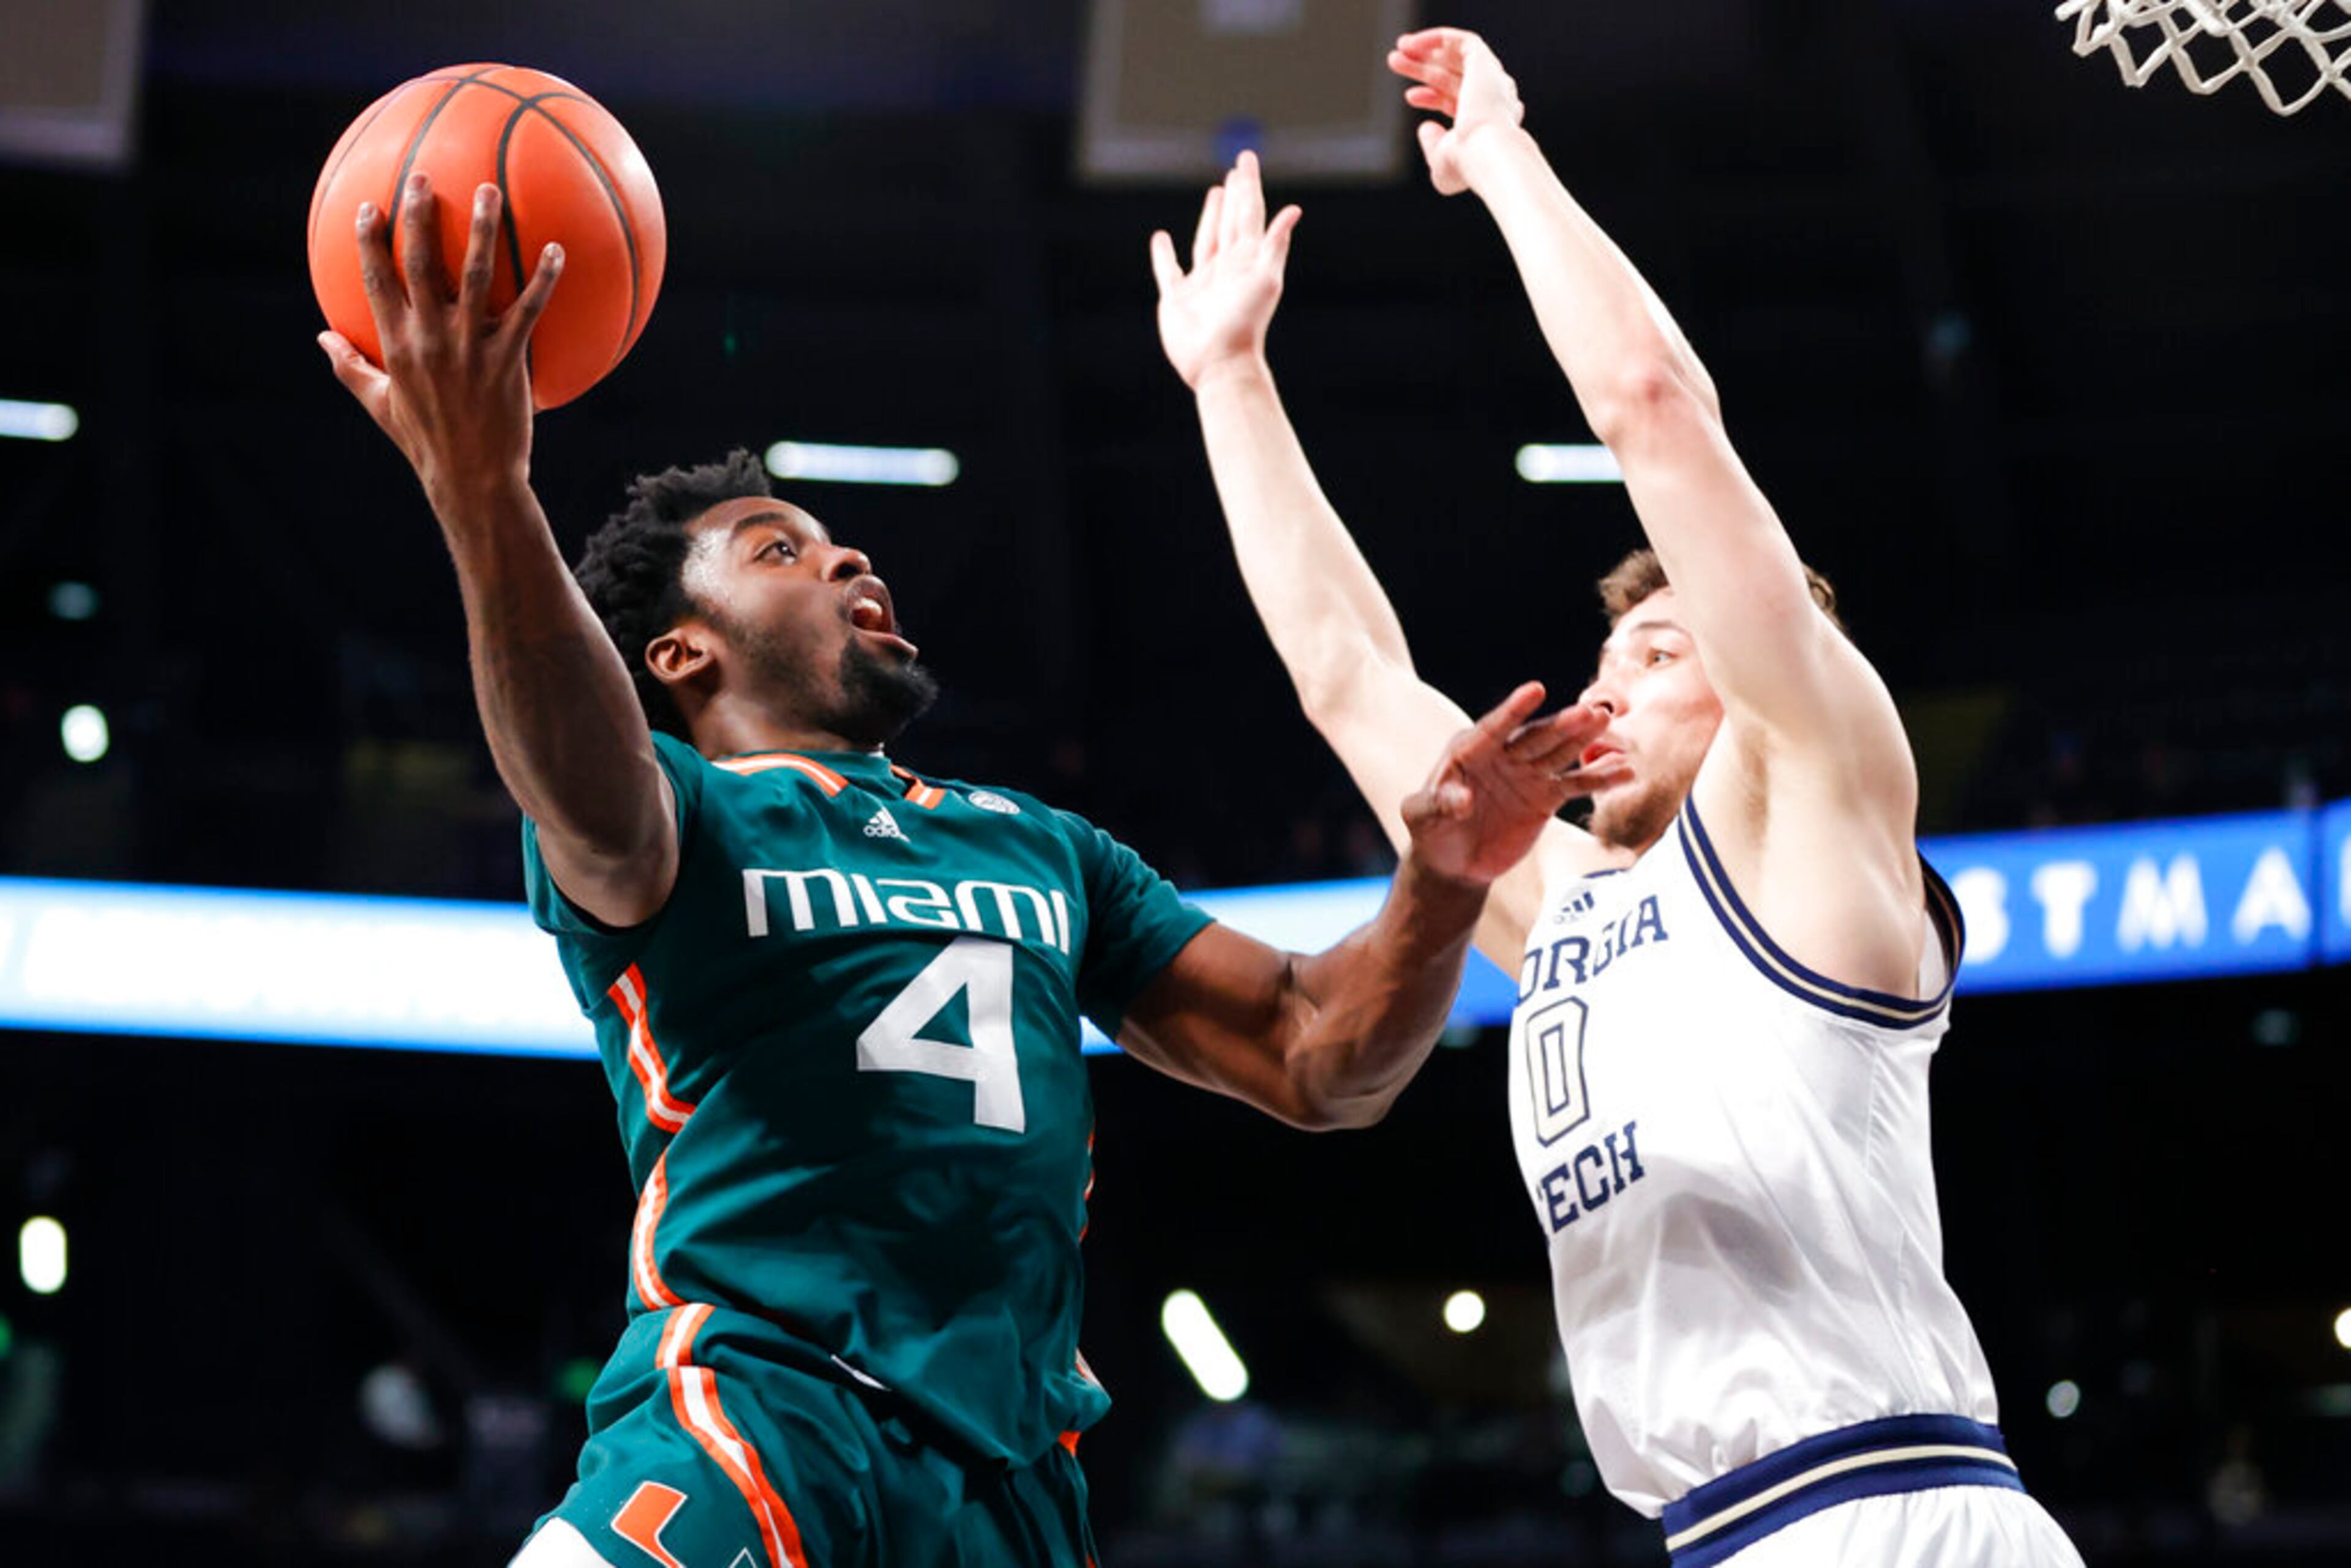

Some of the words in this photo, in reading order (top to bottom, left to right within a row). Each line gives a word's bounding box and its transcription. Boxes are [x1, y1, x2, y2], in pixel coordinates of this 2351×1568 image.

[1952, 834, 2351, 965] STMA
[857, 935, 1025, 1134] 4
[1525, 996, 1591, 1148] 0
[1535, 1120, 1644, 1233] ECH
